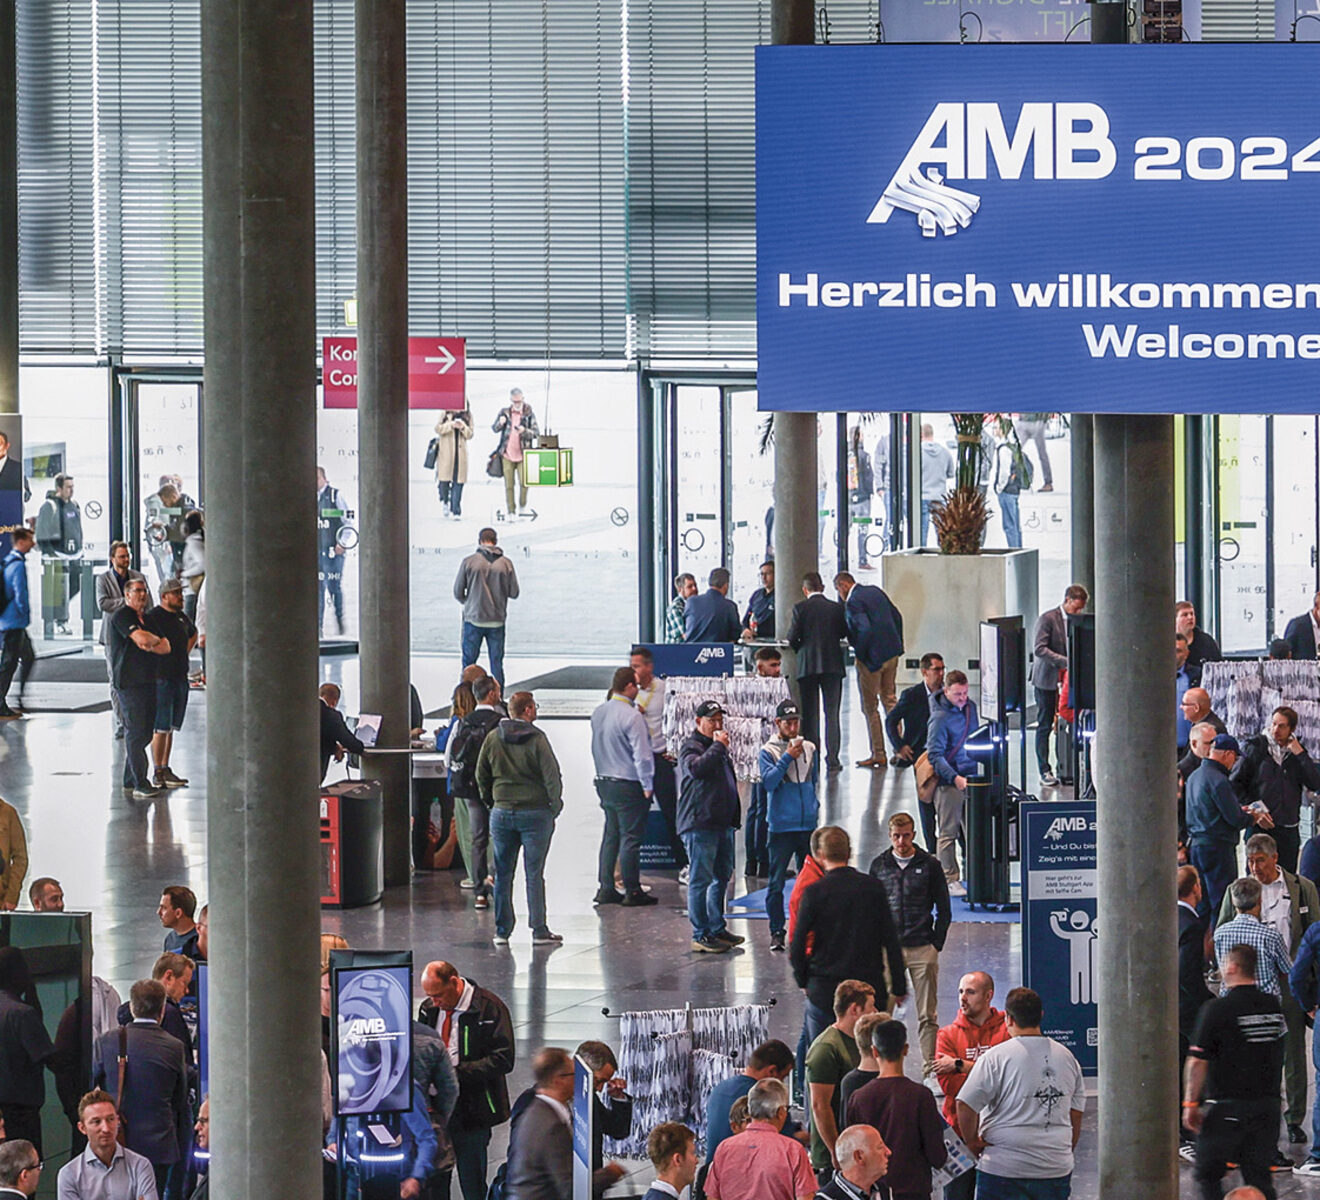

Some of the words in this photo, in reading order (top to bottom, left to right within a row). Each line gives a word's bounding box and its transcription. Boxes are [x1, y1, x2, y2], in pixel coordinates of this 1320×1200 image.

[866, 102, 1118, 225] AMB
[778, 273, 996, 308] Herzlich
[695, 647, 726, 663] AMB
[1043, 817, 1087, 839] AMB
[343, 1018, 386, 1044] AMB
